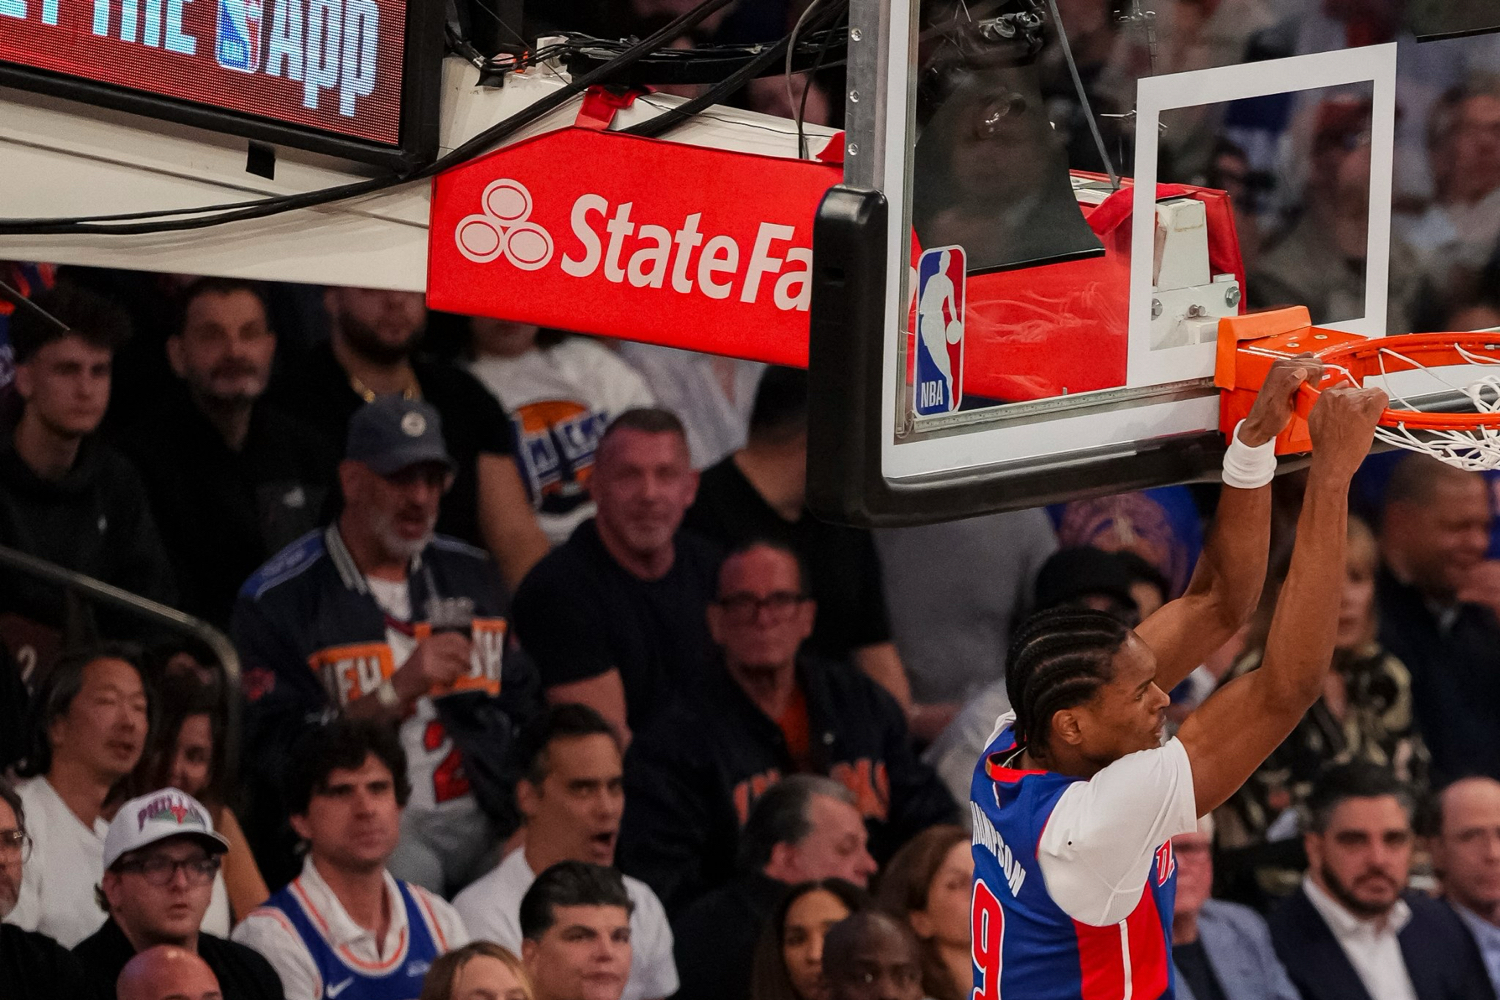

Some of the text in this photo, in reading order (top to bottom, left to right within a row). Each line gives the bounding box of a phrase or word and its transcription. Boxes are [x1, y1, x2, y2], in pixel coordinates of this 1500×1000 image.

[740, 221, 813, 312] Fa
[921, 379, 944, 409] NBA
[970, 800, 1027, 898] HOMPSON
